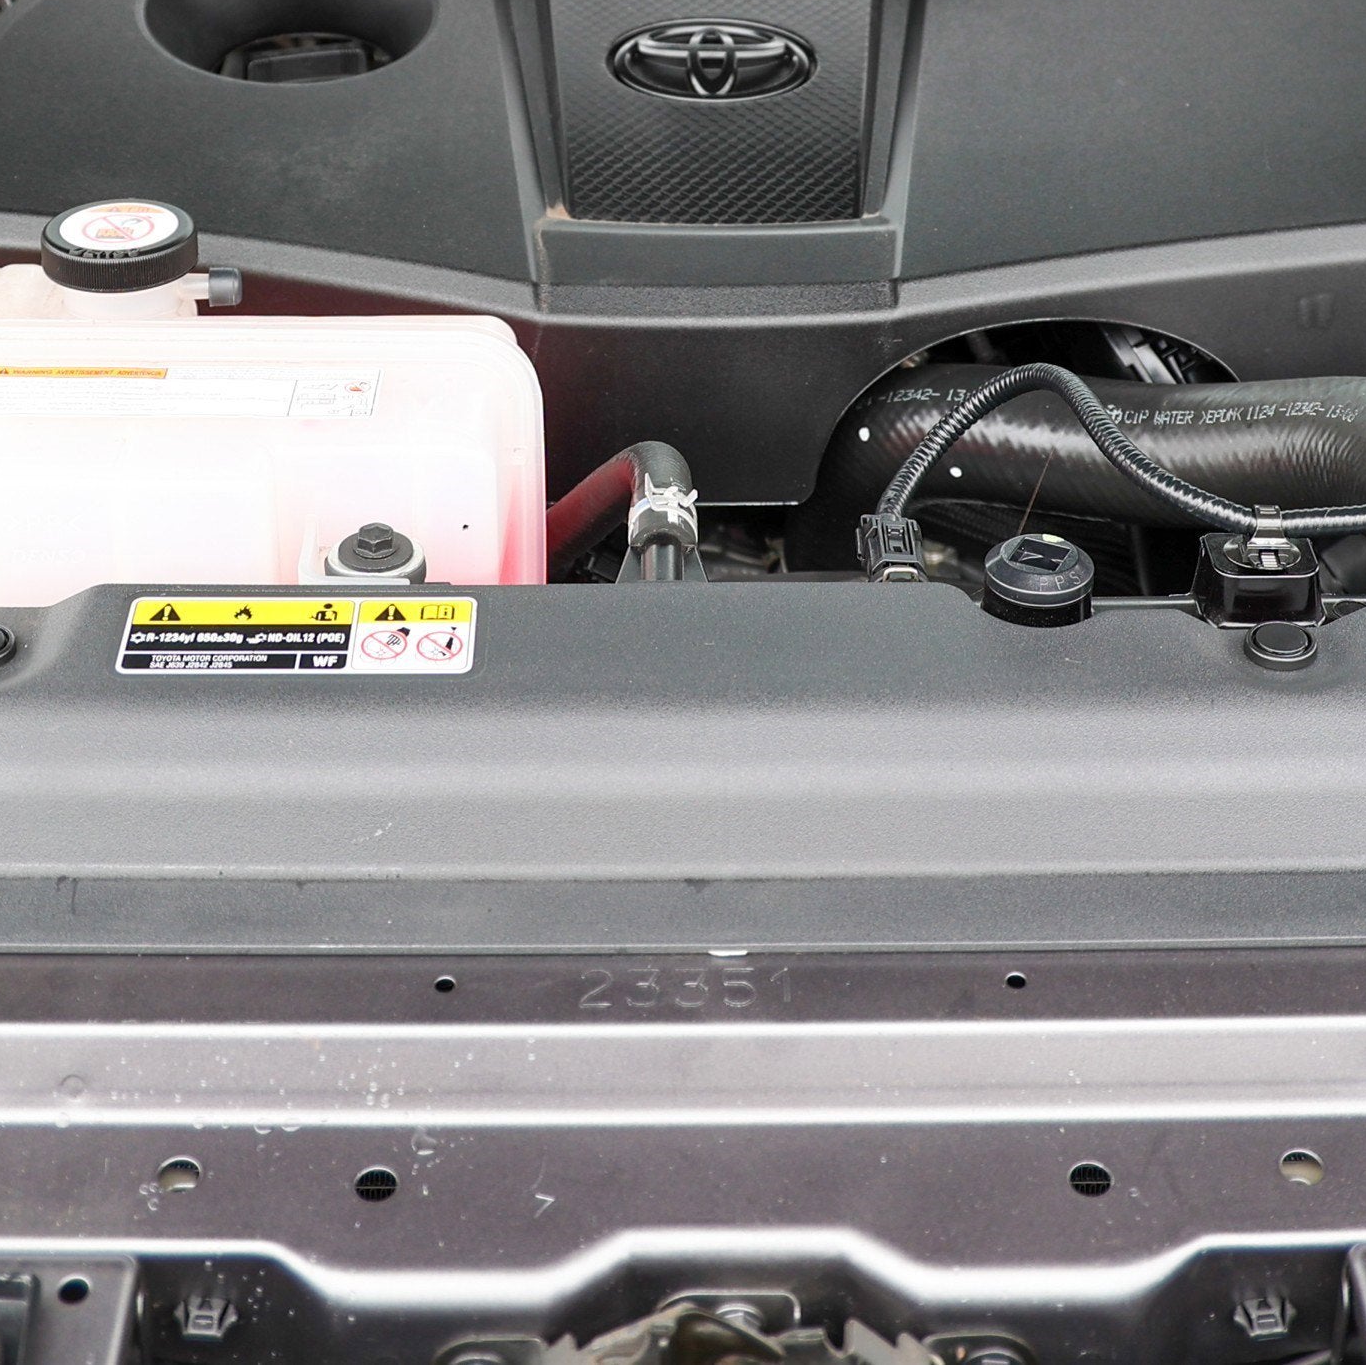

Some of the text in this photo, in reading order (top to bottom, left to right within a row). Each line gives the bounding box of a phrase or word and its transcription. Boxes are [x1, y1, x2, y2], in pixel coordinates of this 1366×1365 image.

[1037, 571, 1082, 592] PPS
[316, 632, 346, 644] (POE)
[151, 654, 268, 662] TOYOTA MOTOR CORPORATION
[312, 655, 338, 668] WF
[149, 661, 165, 669] SAE
[578, 967, 792, 1008] 23351
